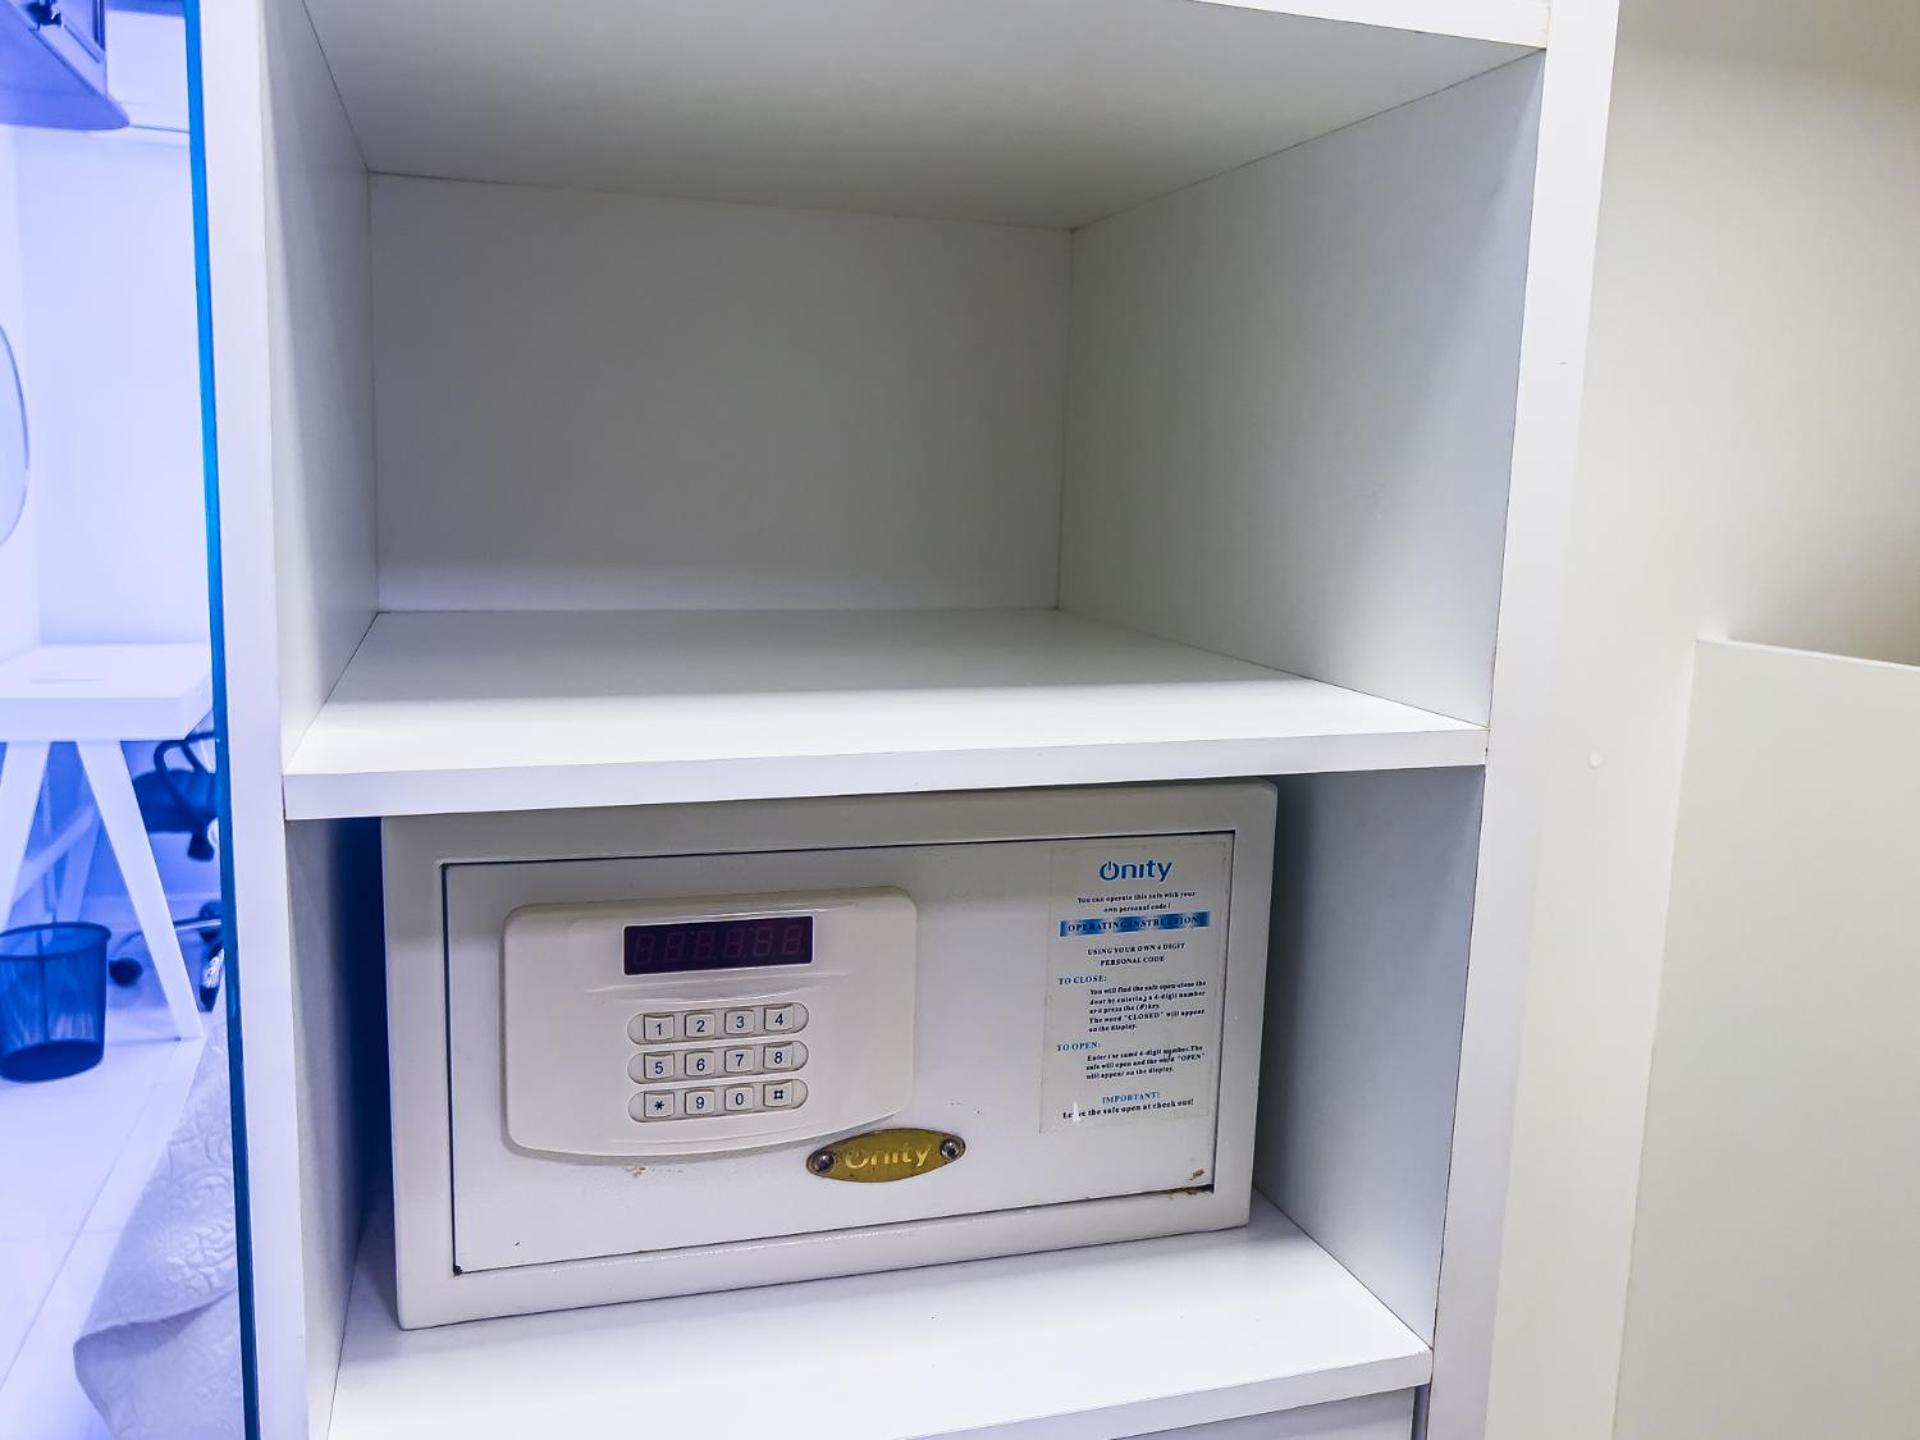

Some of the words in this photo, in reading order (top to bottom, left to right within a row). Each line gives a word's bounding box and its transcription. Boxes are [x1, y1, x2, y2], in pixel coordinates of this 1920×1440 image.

[1100, 860, 1172, 882] Onity
[1120, 905, 1150, 913] personal
[1068, 920, 1127, 931] OPERATING
[1100, 957, 1141, 966] PERSONAL
[1073, 975, 1106, 984] CLOSE:
[656, 1023, 662, 1036] 1
[696, 1019, 705, 1033] 2
[736, 1016, 745, 1029] 3
[774, 1013, 783, 1026] 4
[1071, 1041, 1100, 1050] OPEN:
[654, 1061, 663, 1074] 5
[696, 1058, 705, 1071] 6
[735, 1054, 744, 1067] 7
[774, 1051, 783, 1064] 8
[696, 1096, 705, 1110] 9
[735, 1092, 744, 1106] 0
[1102, 1091, 1160, 1104] IMPORTANT!
[1102, 1106, 1119, 1114] safe
[1121, 1105, 1141, 1113] open
[1152, 1100, 1176, 1109] check
